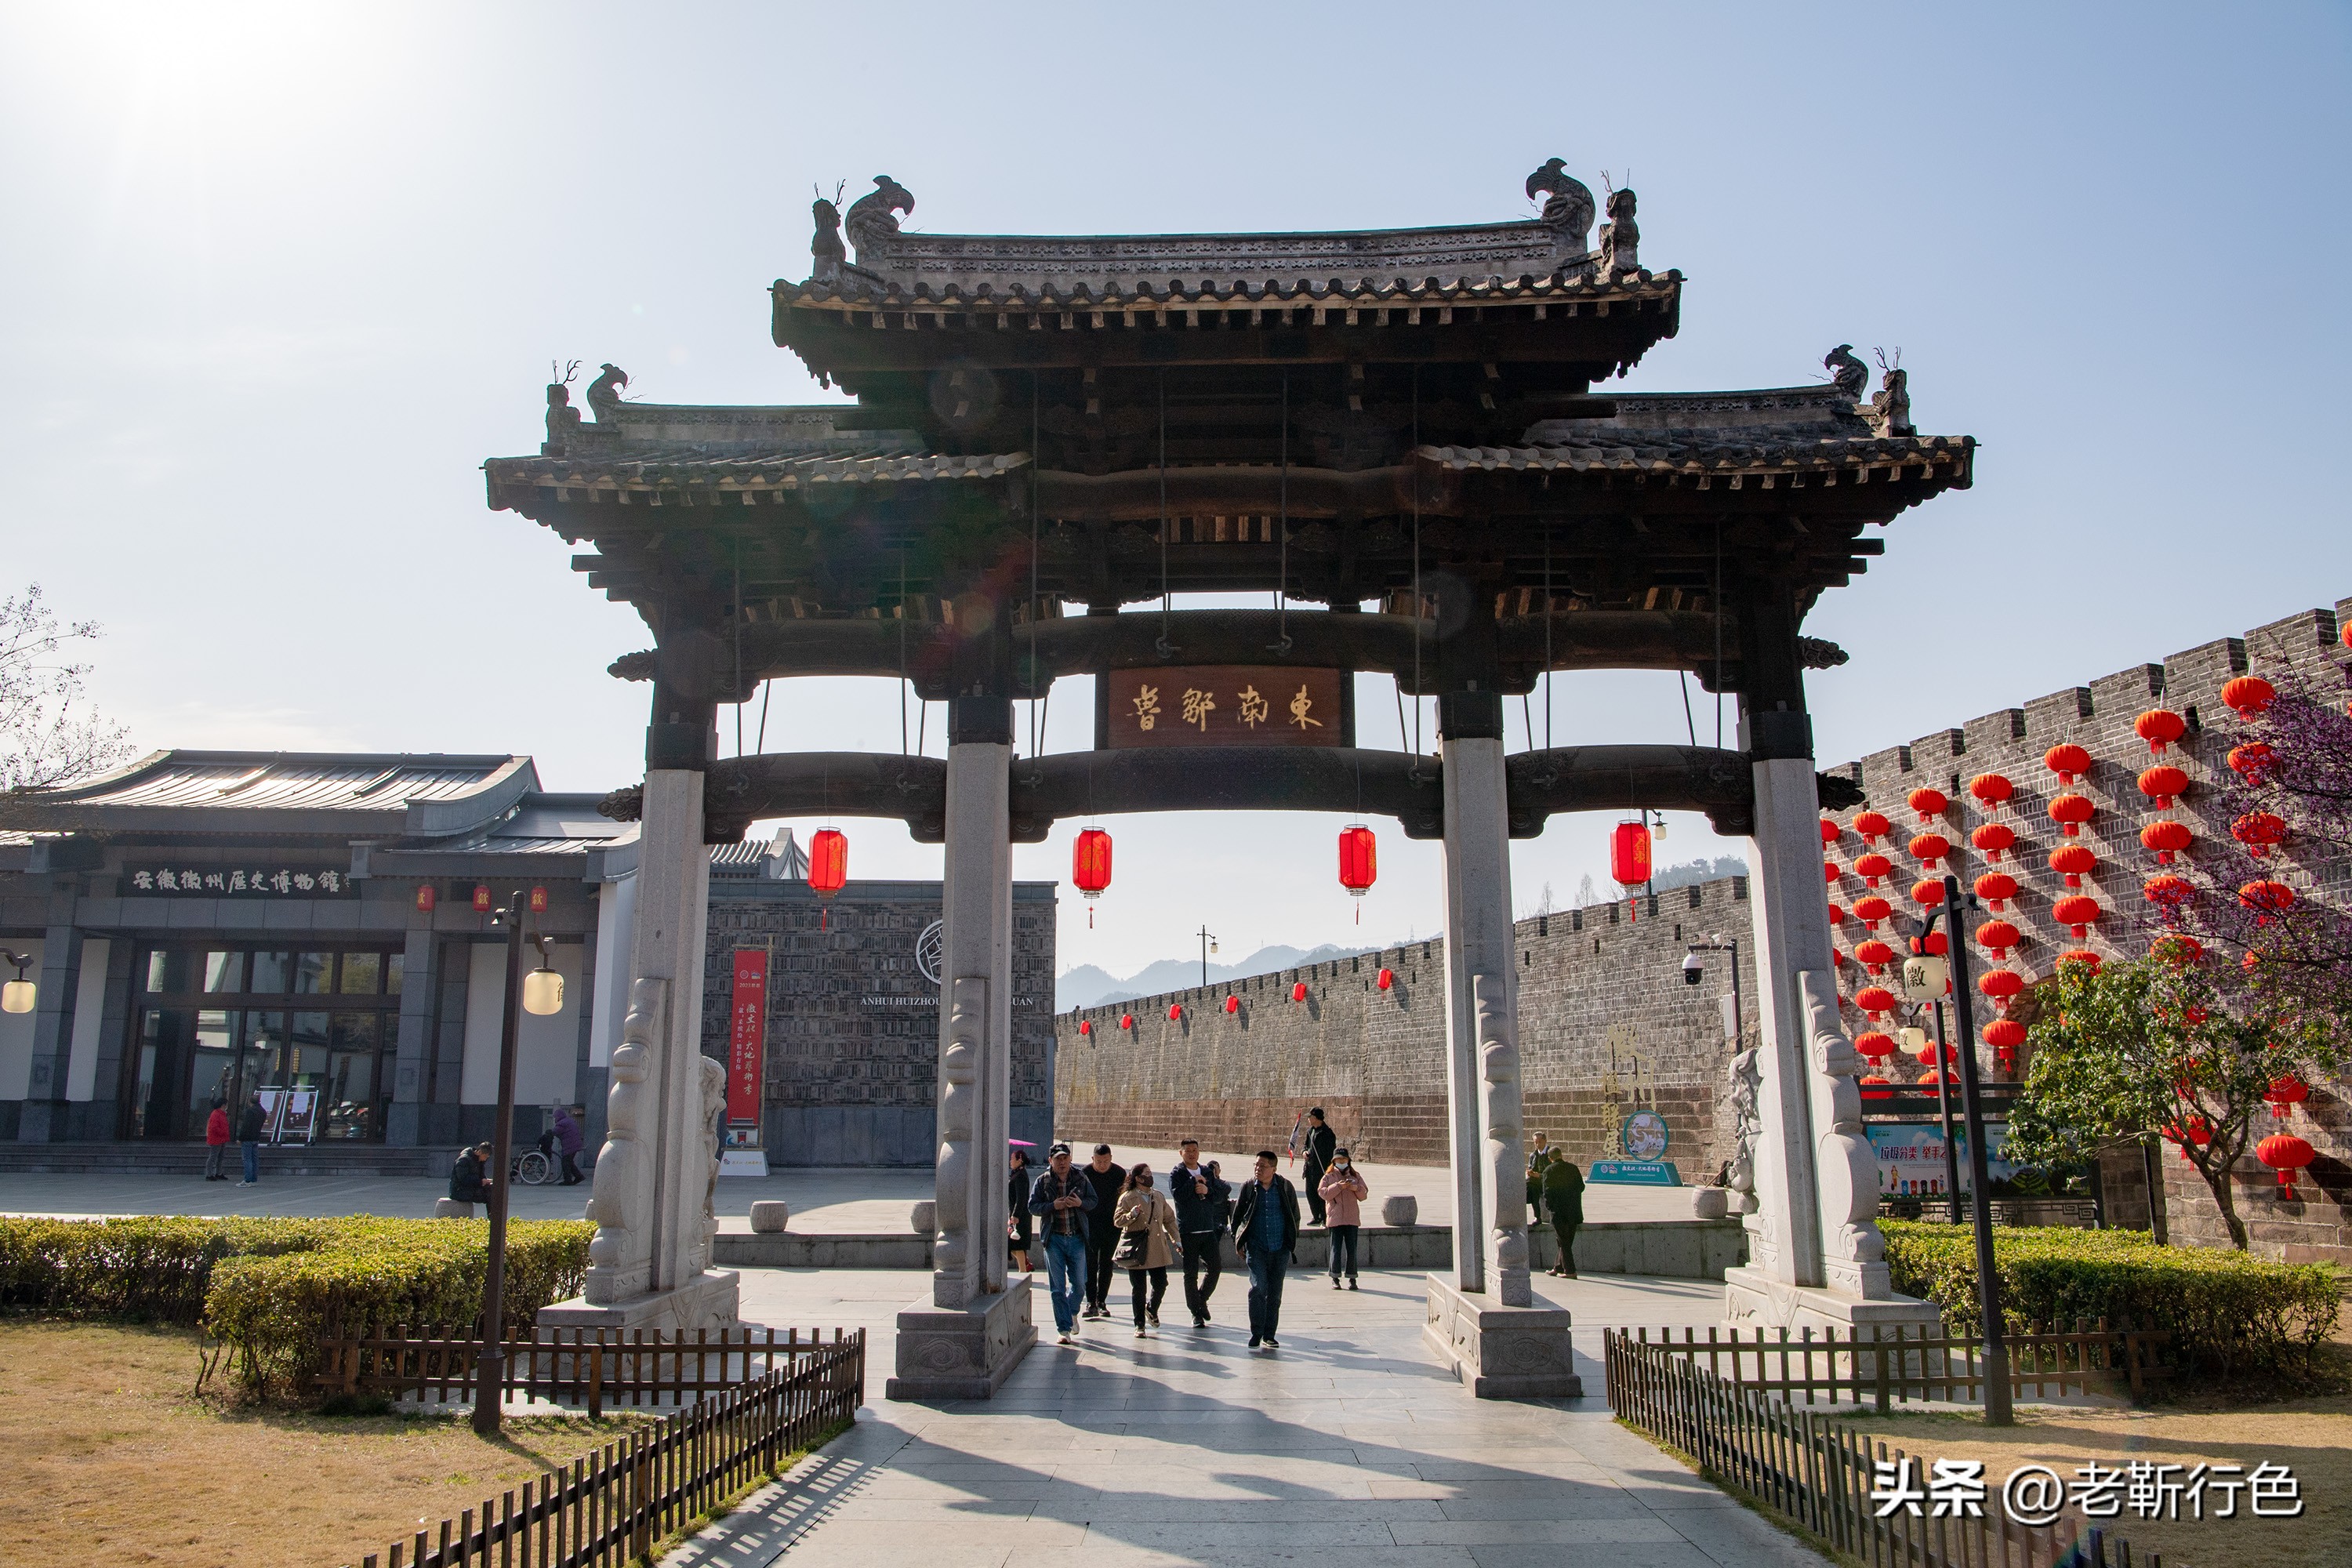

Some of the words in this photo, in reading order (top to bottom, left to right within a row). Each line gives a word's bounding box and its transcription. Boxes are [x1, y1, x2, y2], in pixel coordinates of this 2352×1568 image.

[1906, 966, 1927, 988] 徽
[860, 997, 893, 1006] ANHUI
[1880, 1145, 1918, 1160] 垃圾分类
